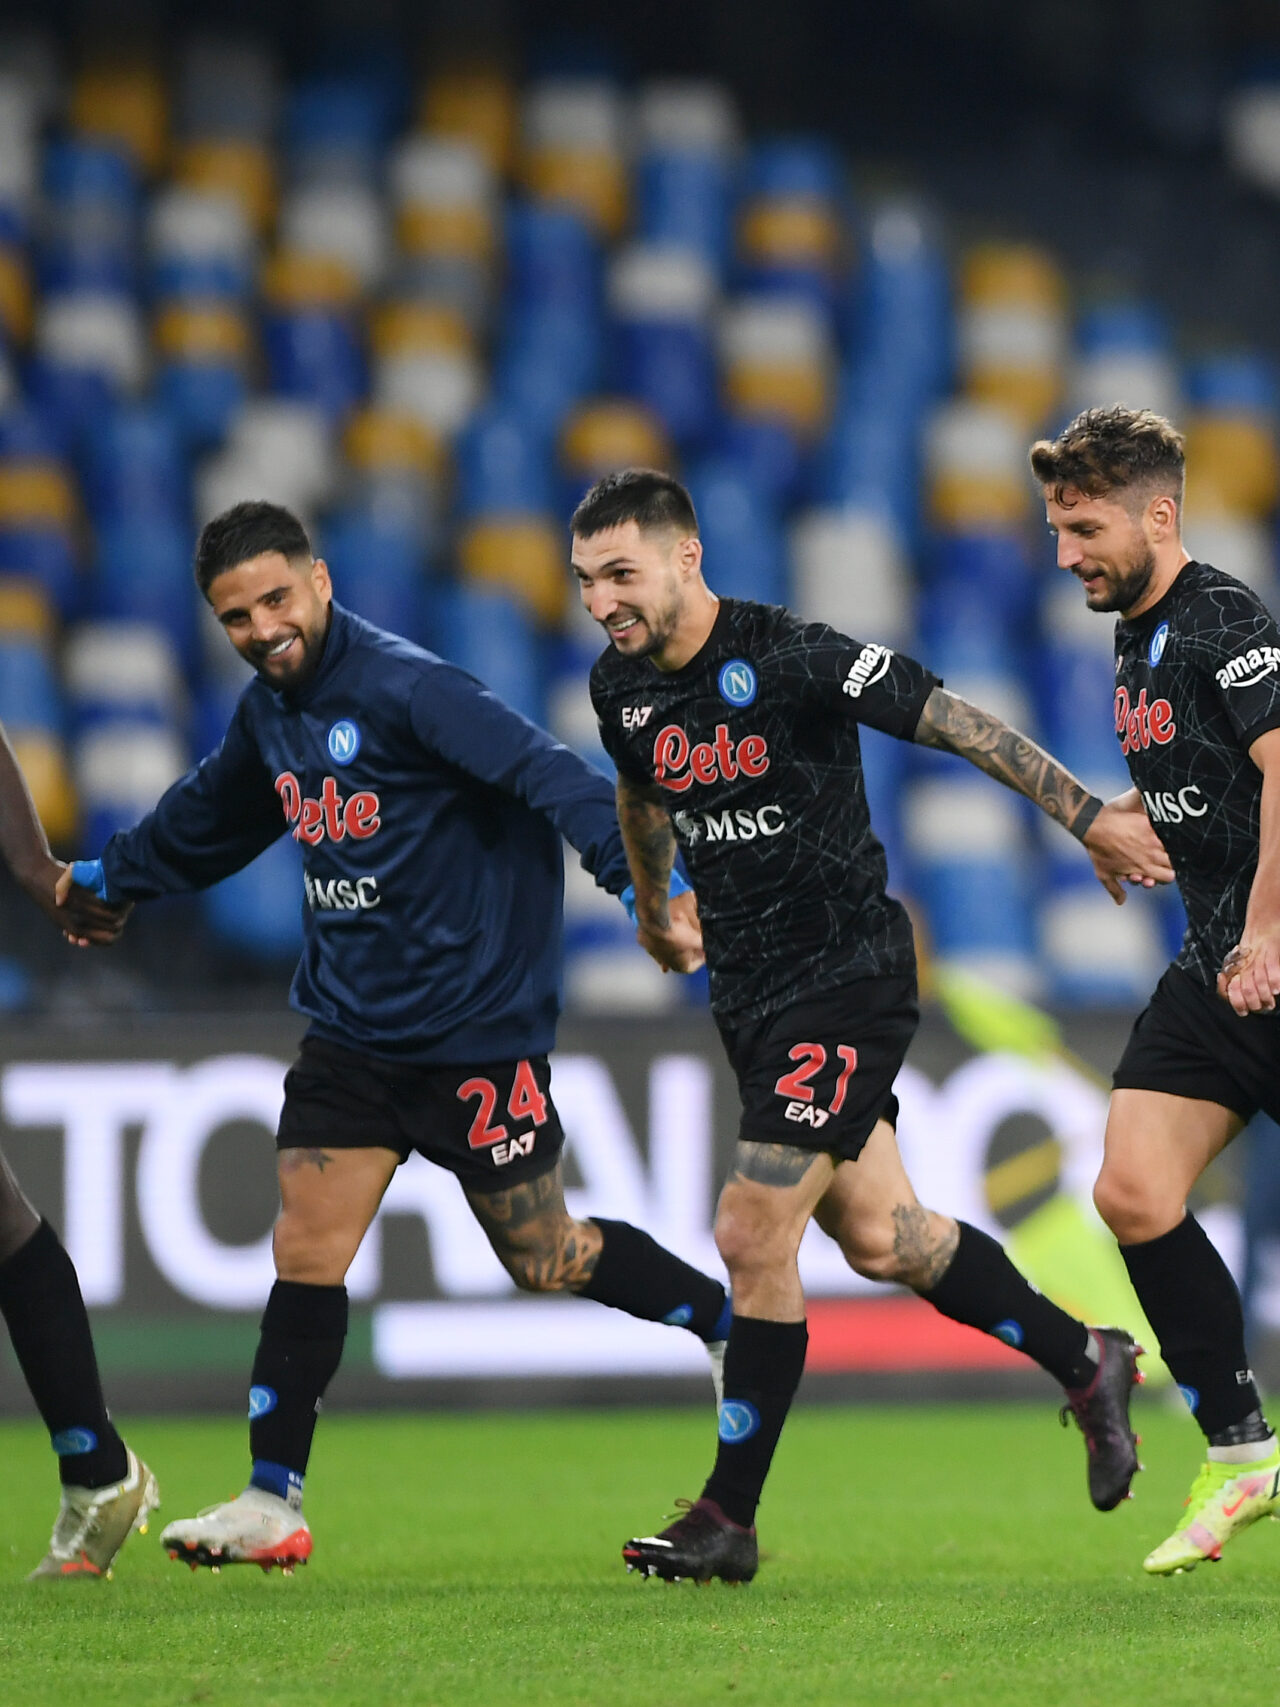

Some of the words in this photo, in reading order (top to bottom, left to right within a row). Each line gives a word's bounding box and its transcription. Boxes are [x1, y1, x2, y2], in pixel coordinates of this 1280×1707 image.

[730, 670, 748, 695] N
[842, 643, 887, 698] amaz
[622, 706, 653, 728] EA7
[335, 729, 350, 753] N
[653, 723, 770, 793] Lete
[1144, 784, 1208, 824] MSC
[705, 804, 786, 842] MSC
[314, 876, 381, 910] MSC
[774, 1042, 858, 1115] 21
[456, 1059, 547, 1150] 24
[784, 1101, 830, 1129] EA7
[491, 1130, 536, 1166] EA7
